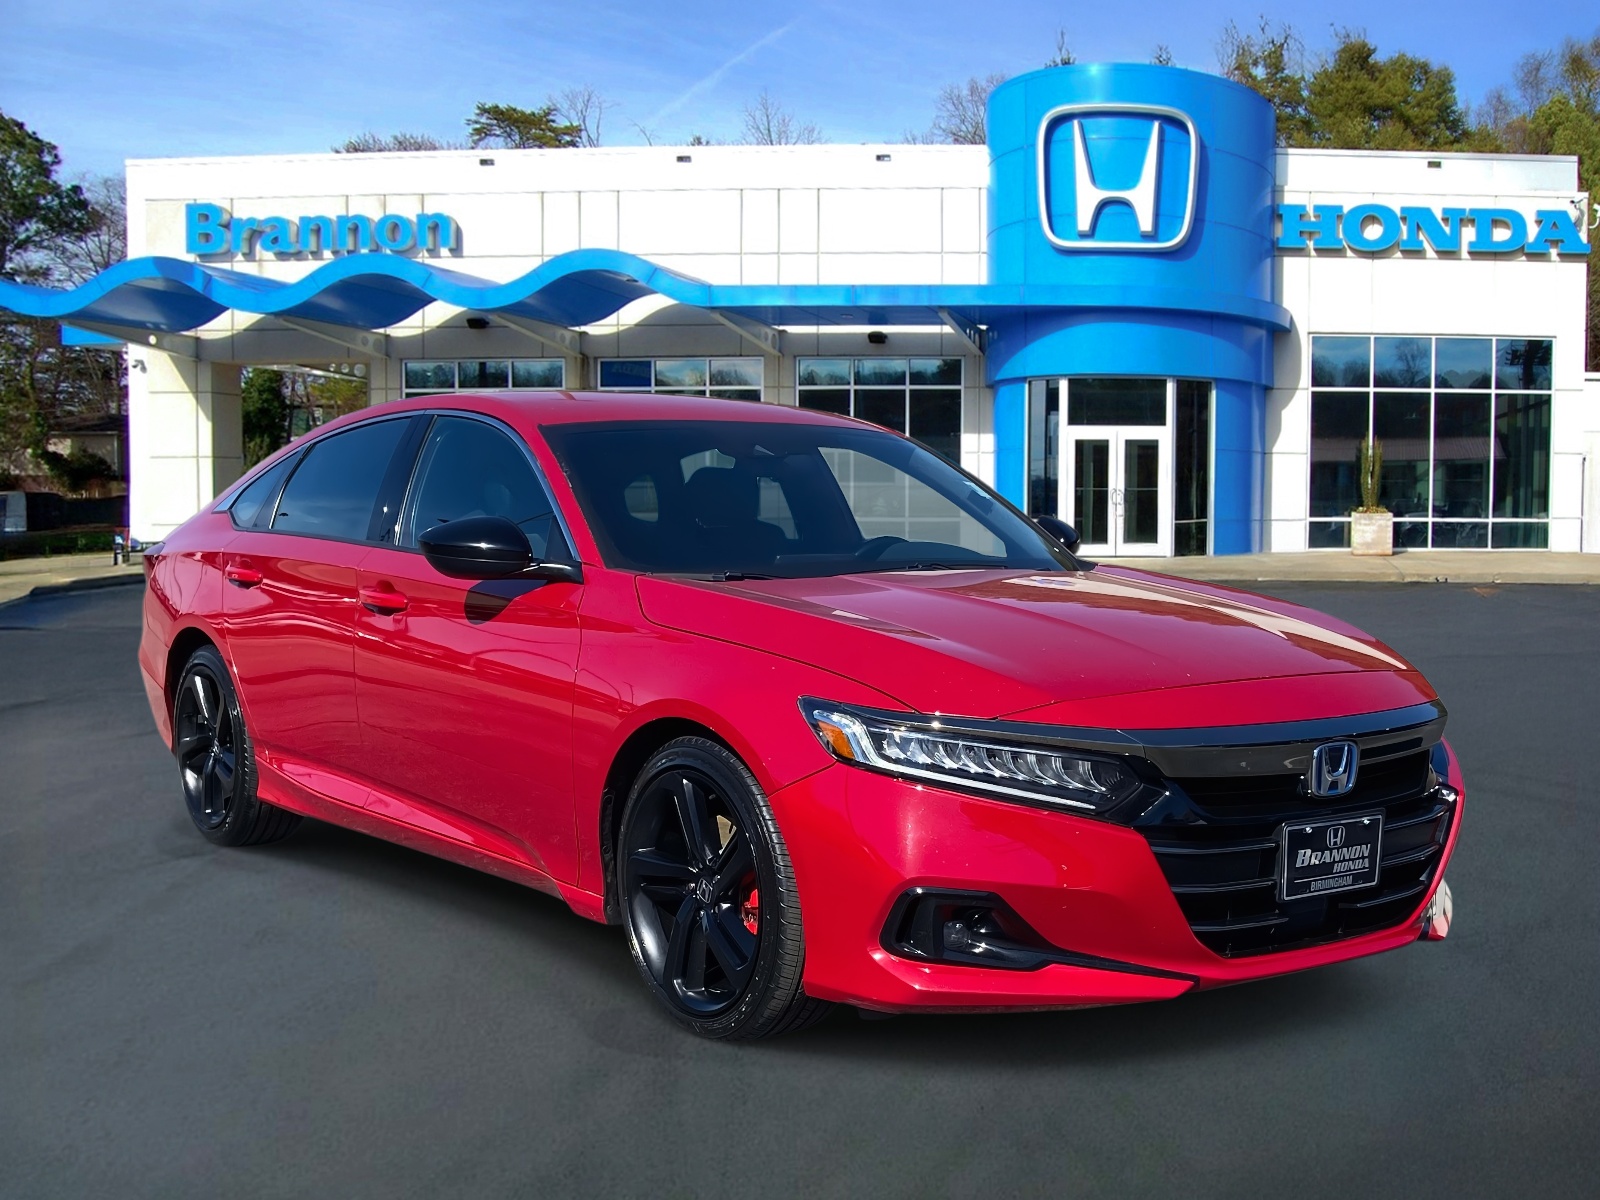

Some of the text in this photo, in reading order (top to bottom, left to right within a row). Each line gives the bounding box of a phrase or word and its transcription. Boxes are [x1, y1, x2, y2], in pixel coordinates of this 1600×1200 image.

[184, 203, 457, 255] Brannon
[1276, 203, 1592, 255] HONDA
[1295, 843, 1371, 868] BRANNON
[1333, 858, 1370, 873] HONDA
[1310, 875, 1353, 892] BIRMINGHAM
